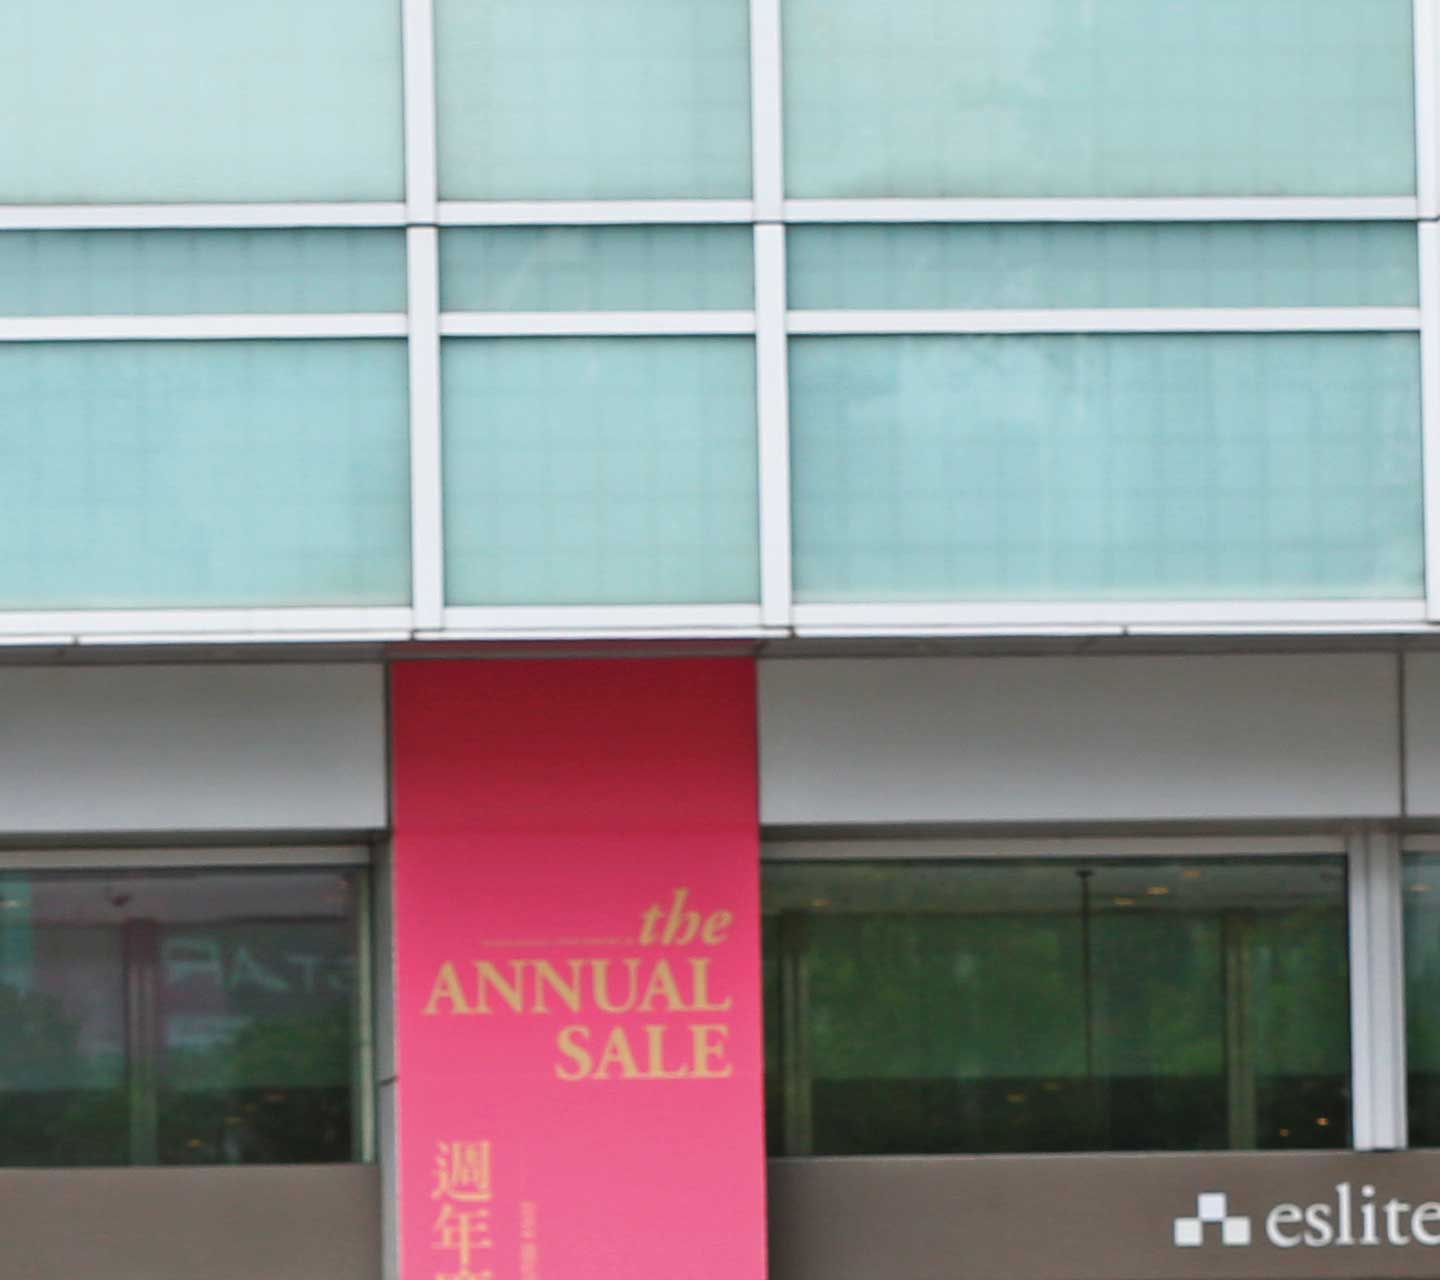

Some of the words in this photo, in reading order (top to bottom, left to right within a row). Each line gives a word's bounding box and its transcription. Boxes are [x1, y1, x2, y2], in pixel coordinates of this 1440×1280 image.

[638, 887, 733, 947] the
[423, 956, 733, 1016] ANNUAL
[554, 1024, 733, 1082] SALE
